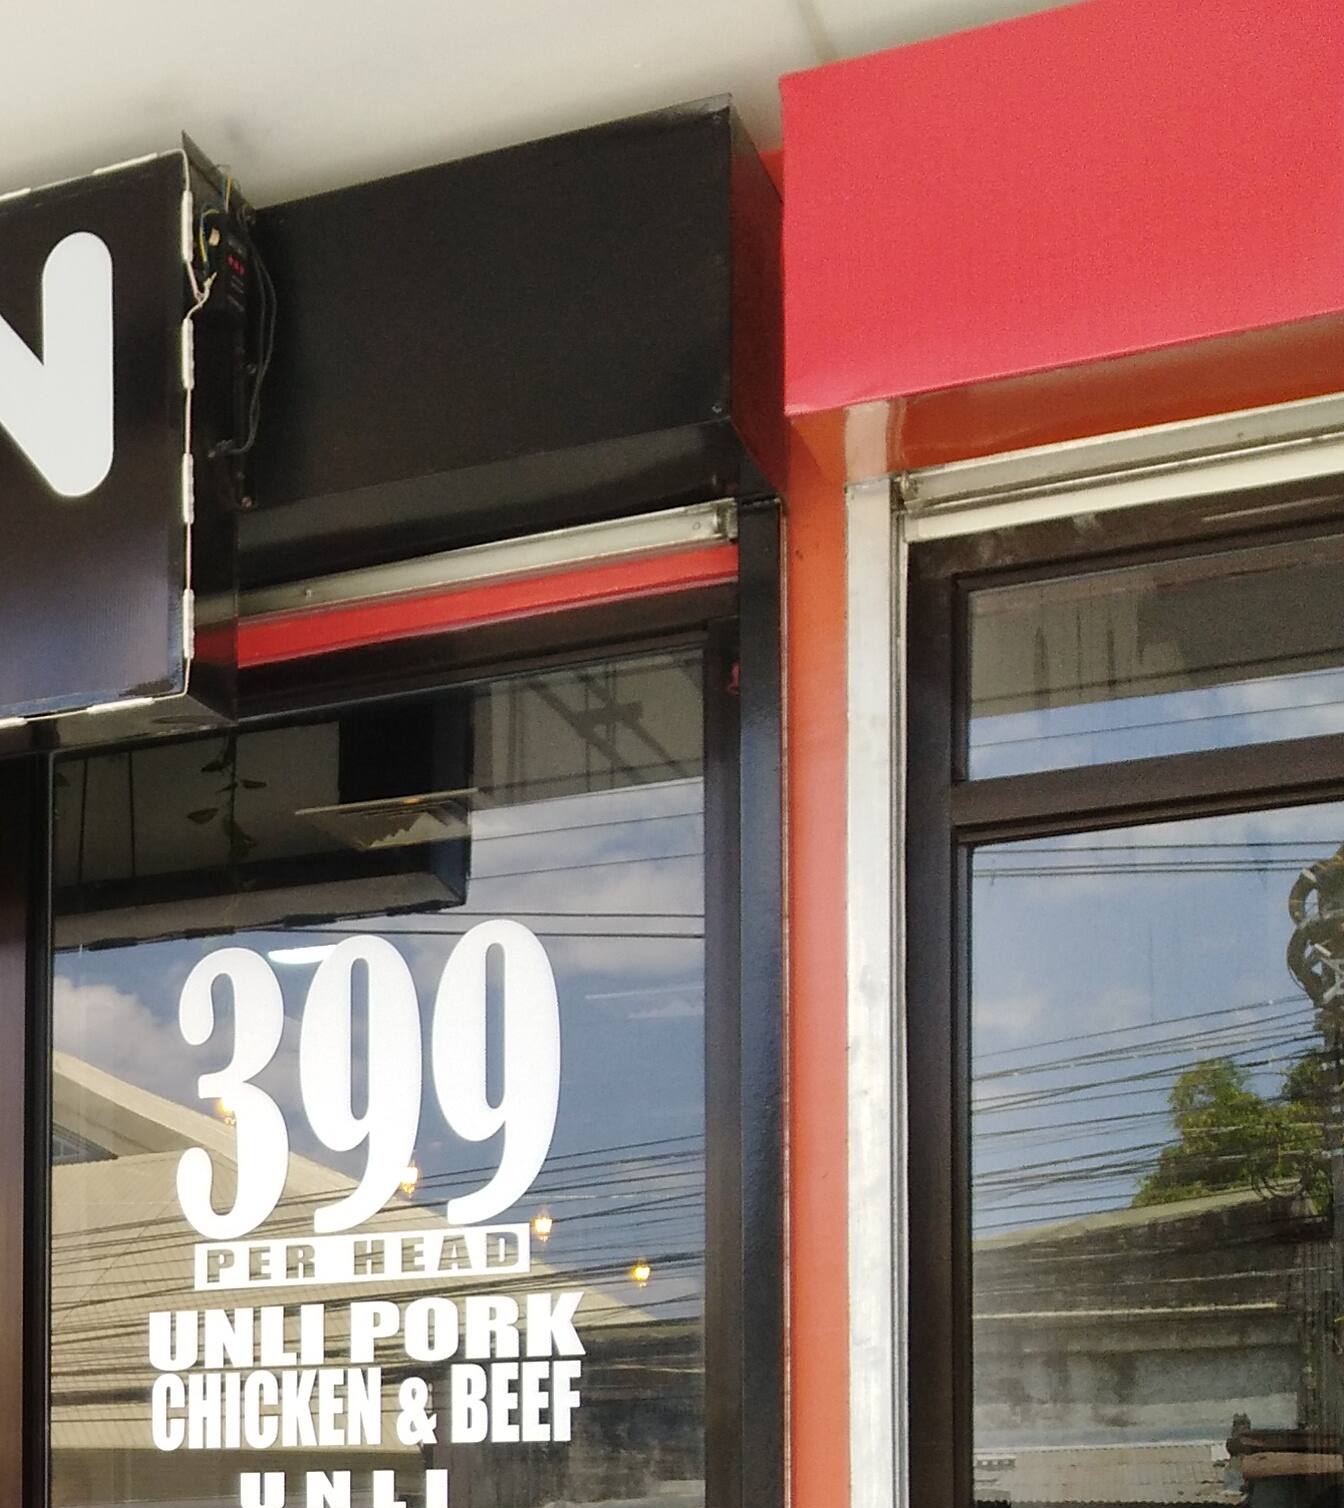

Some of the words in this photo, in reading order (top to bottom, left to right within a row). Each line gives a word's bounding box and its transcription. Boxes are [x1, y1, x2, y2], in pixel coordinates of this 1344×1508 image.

[177, 919, 561, 1239] 399
[206, 1243, 315, 1284] PER
[353, 1231, 521, 1274] HEAD
[148, 1308, 326, 1372] UNLI
[350, 1291, 586, 1361] PORK
[151, 1366, 382, 1451] CHICKEN
[396, 1377, 437, 1446] &
[451, 1360, 581, 1443] BEEF
